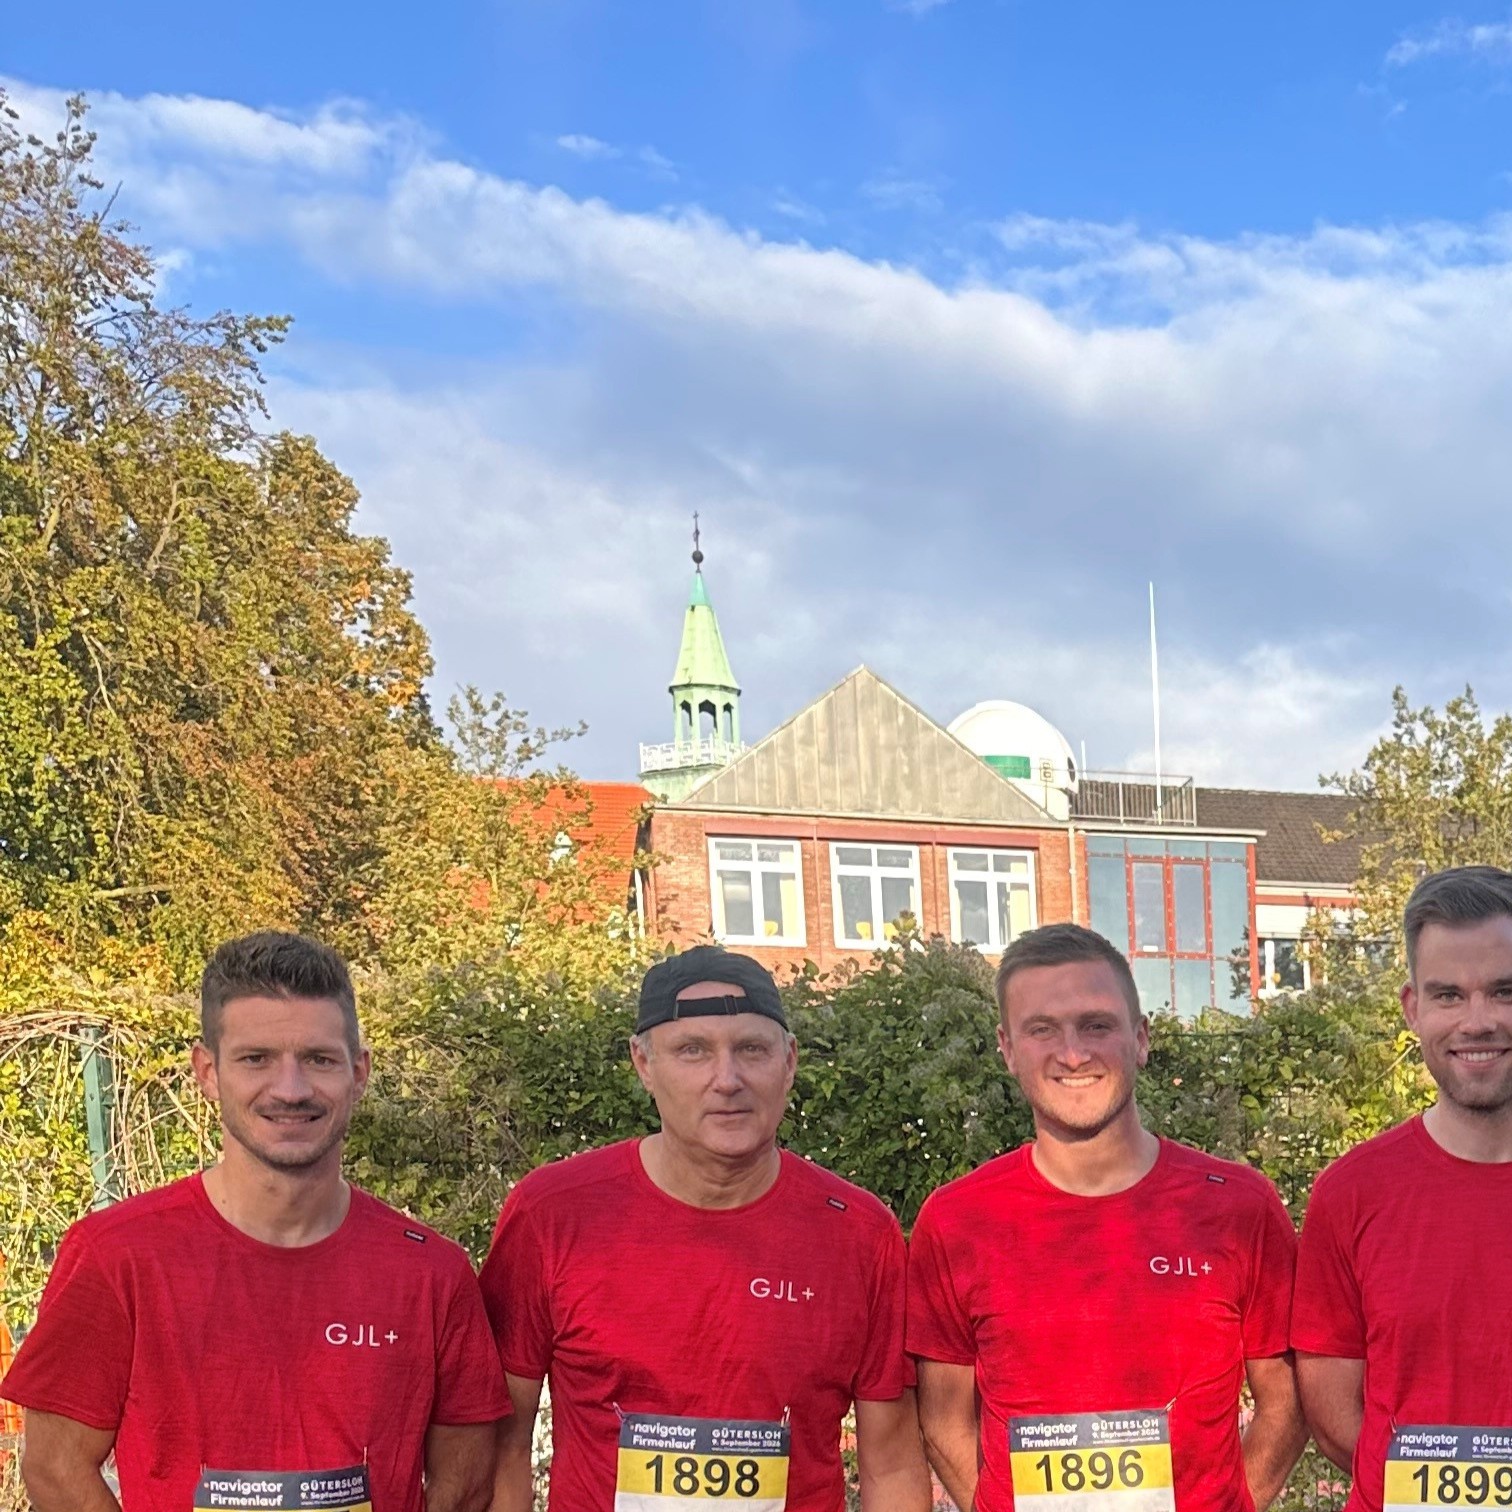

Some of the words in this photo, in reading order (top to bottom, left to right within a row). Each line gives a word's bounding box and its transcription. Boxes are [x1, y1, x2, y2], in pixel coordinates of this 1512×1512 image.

[1149, 1256, 1212, 1276] GJL+
[749, 1278, 814, 1302] GJL+
[325, 1323, 398, 1347] GJL+
[634, 1422, 696, 1438] navigator
[1020, 1422, 1077, 1437] navigator
[1091, 1418, 1159, 1432] GÜTERSLOH
[633, 1434, 696, 1450] Firmenlauf
[712, 1428, 781, 1440] GÜTERSLOH
[1021, 1435, 1078, 1448] Firmenlauf
[1400, 1433, 1458, 1447] navigator
[1400, 1446, 1458, 1458] Firmenlauf
[646, 1454, 760, 1498] 1898
[1036, 1449, 1144, 1492] 1896
[210, 1479, 283, 1495] navigator
[300, 1475, 363, 1492] GÜTERSLOH
[210, 1493, 283, 1507] Firmenlauf
